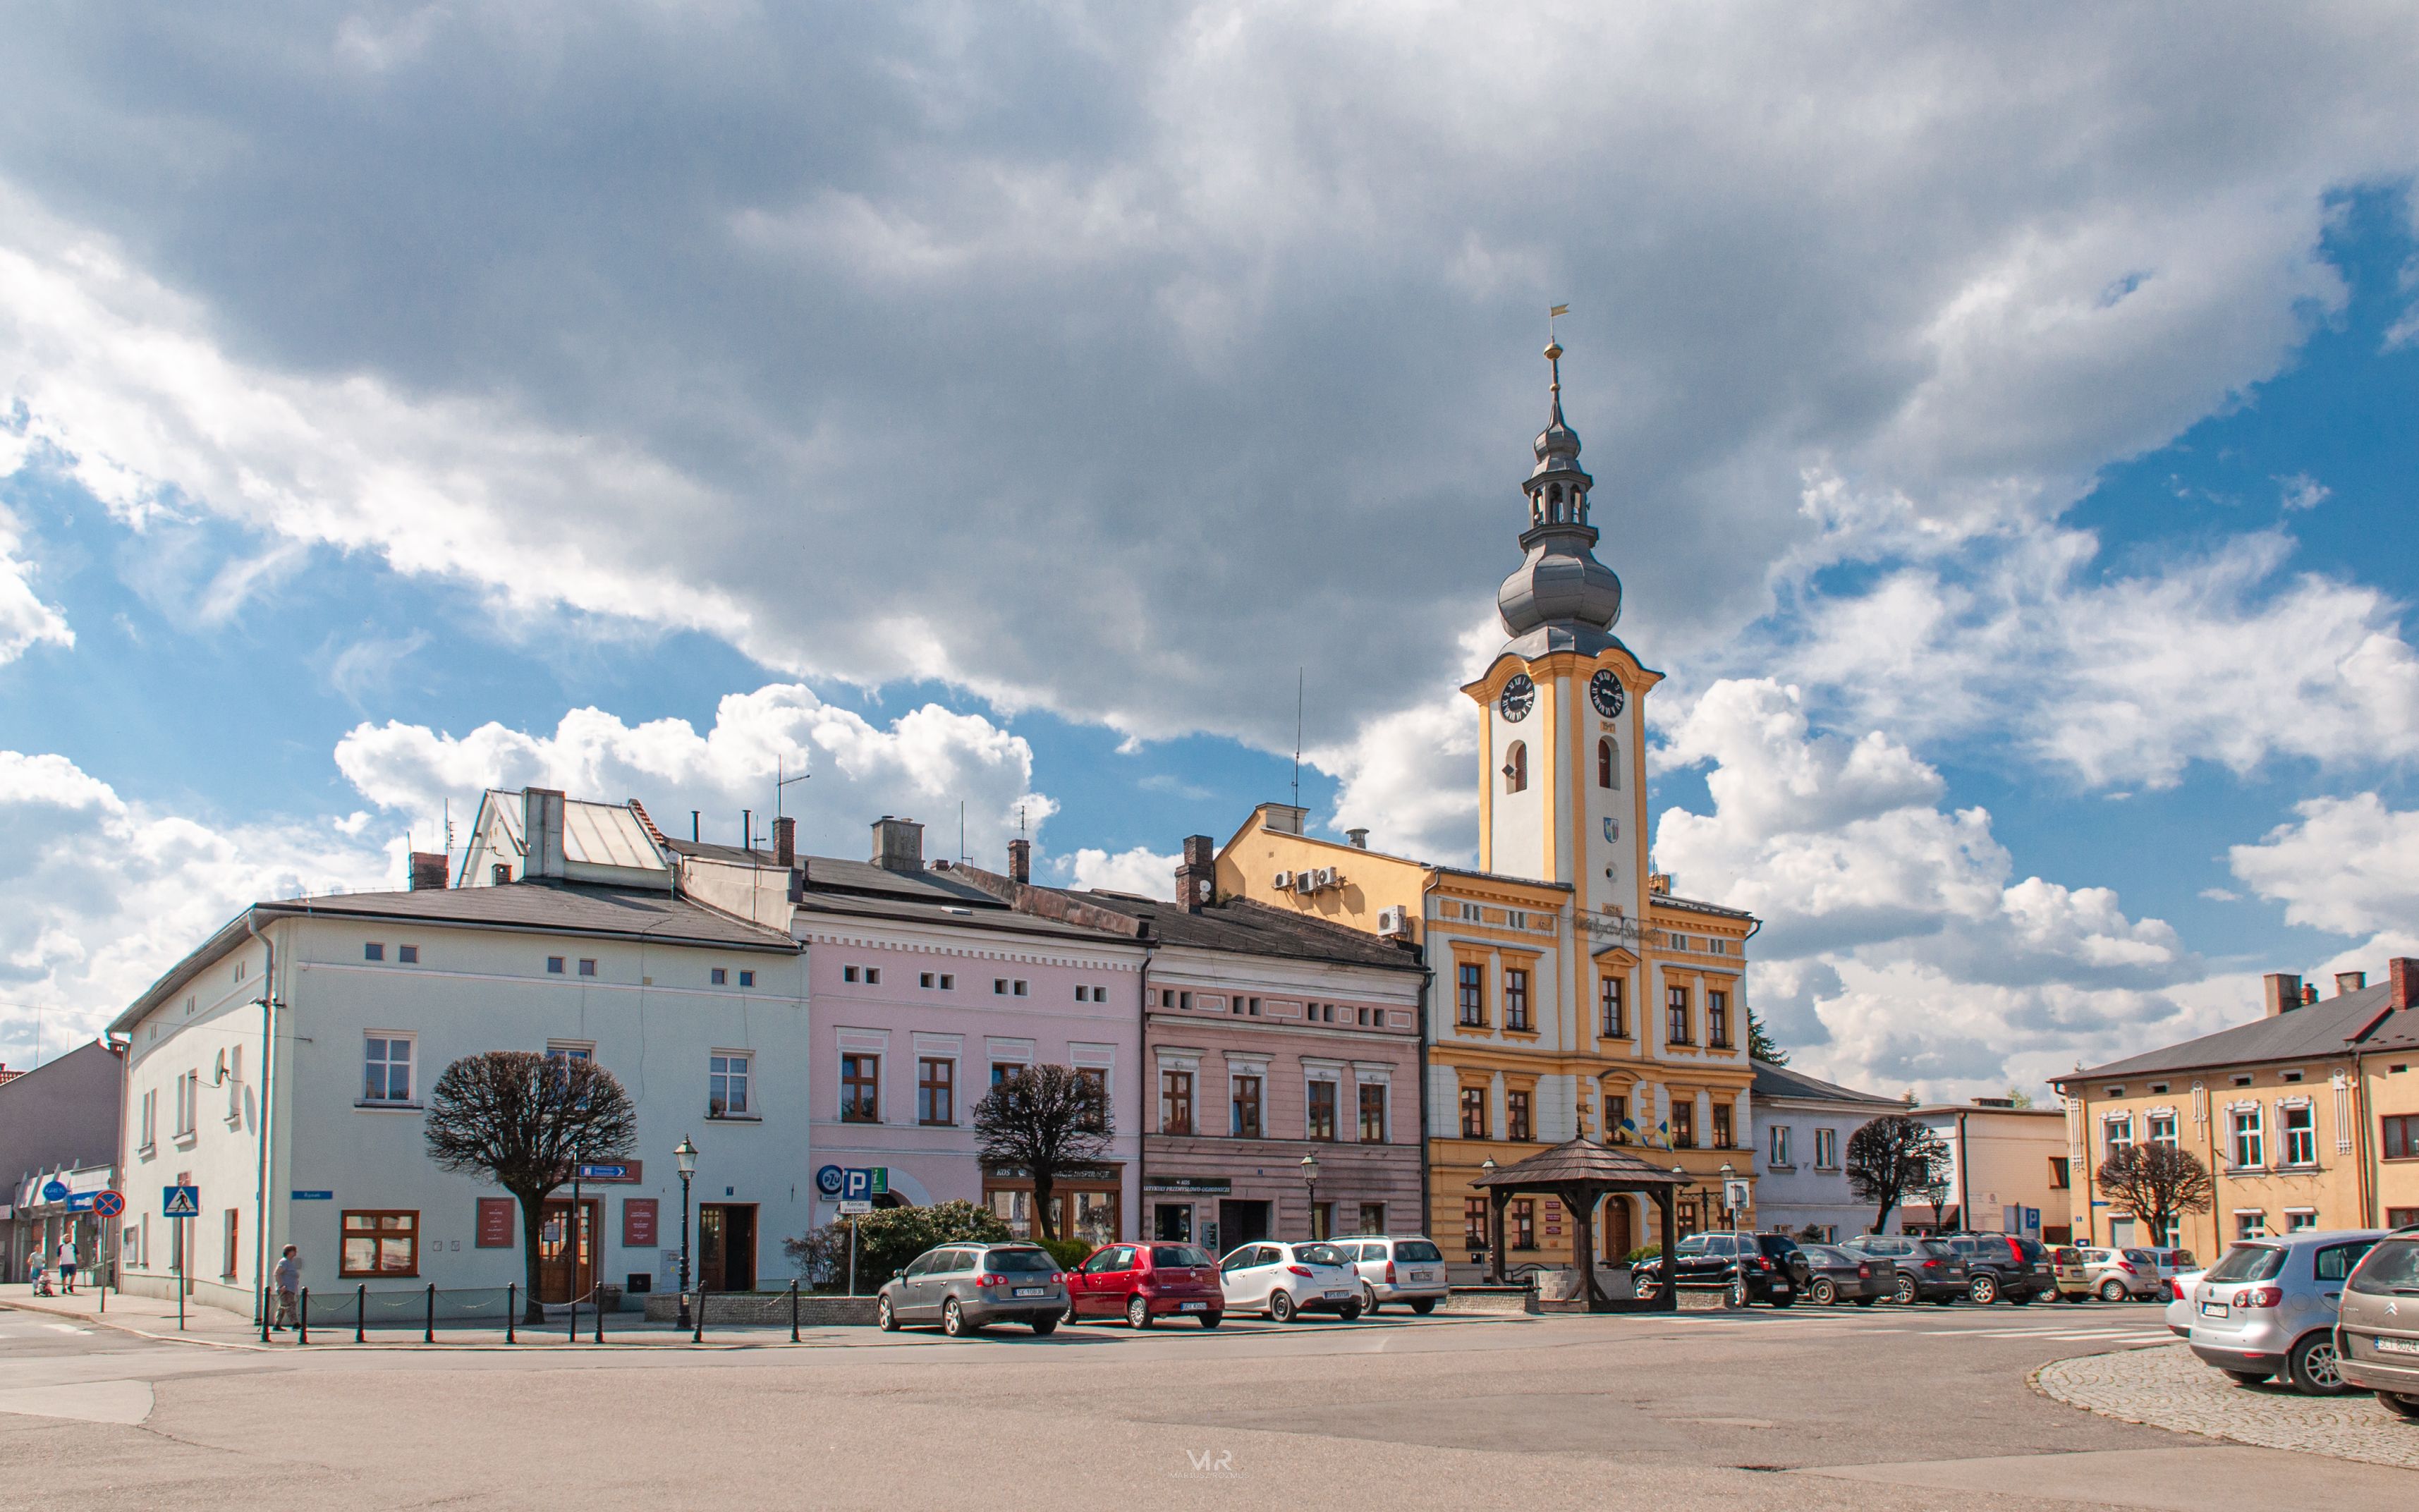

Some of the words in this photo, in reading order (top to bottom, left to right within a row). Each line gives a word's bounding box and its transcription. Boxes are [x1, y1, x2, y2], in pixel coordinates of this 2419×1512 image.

[824, 1173, 840, 1186] PZU
[849, 1172, 866, 1196] P
[2029, 1211, 2037, 1226] P
